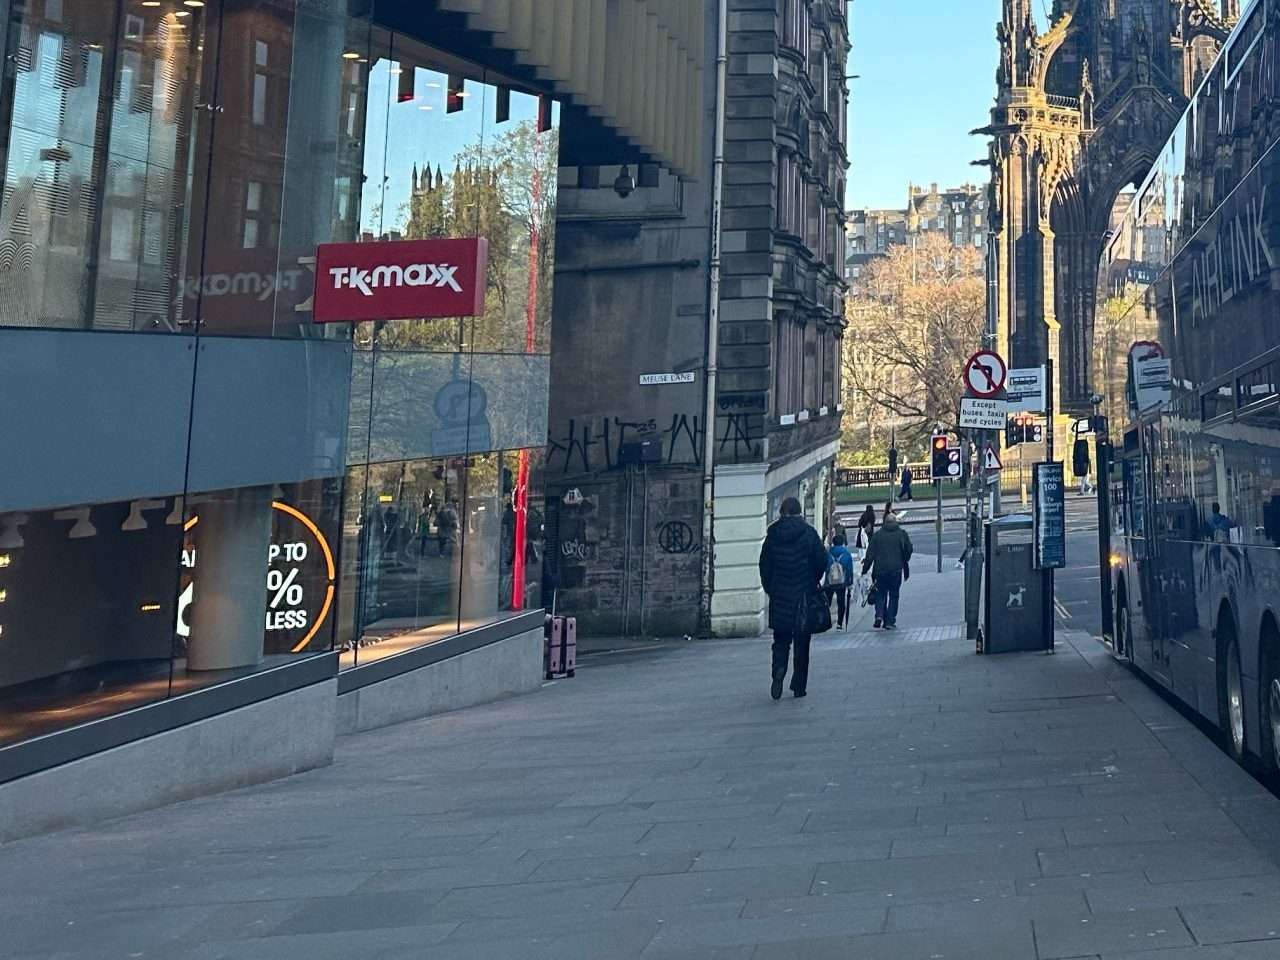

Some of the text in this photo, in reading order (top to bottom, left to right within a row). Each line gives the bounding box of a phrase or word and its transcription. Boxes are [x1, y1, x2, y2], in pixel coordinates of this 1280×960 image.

[1191, 183, 1274, 329] AIRLINK
[972, 400, 997, 409] Except
[979, 418, 1002, 427] cycles
[1043, 483, 1057, 491] 100
[283, 542, 308, 562] TO
[265, 609, 308, 630] LESS
